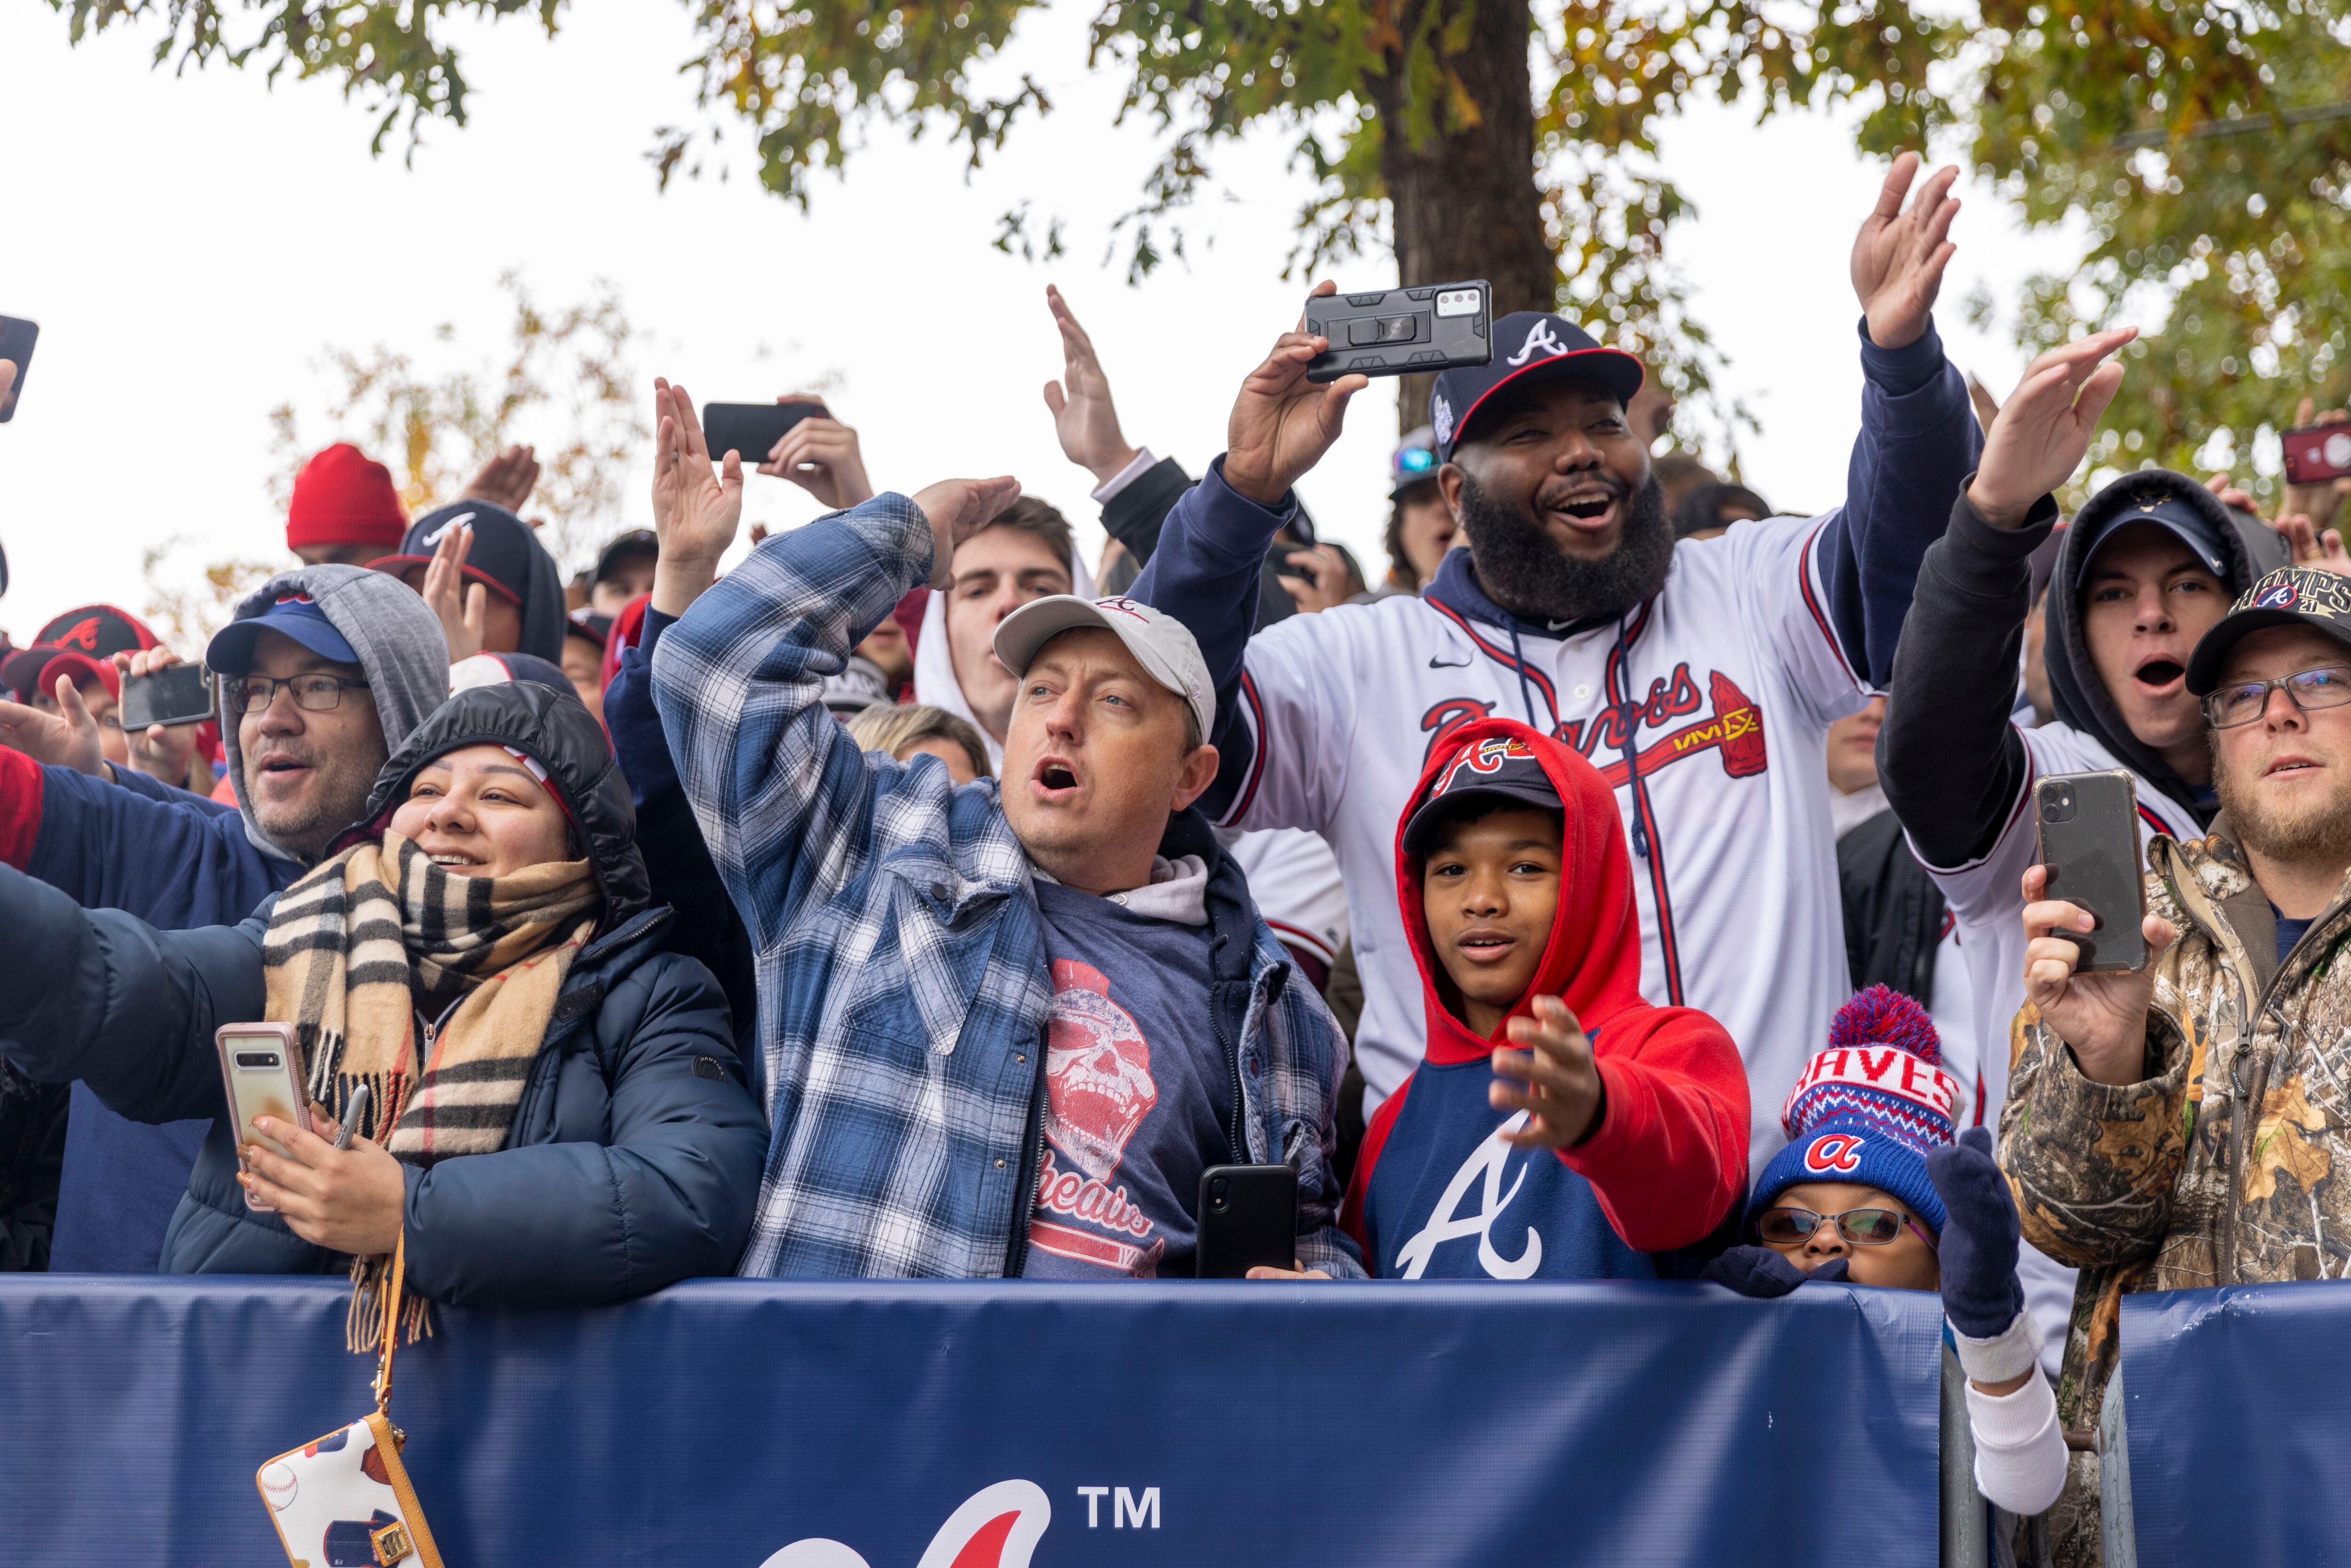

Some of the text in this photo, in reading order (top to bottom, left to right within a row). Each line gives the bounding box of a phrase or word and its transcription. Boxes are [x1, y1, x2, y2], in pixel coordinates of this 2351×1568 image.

[1507, 318, 1568, 366] A
[2256, 585, 2289, 607] A
[2299, 600, 2315, 612] 21
[54, 616, 101, 651] A
[2233, 1072, 2243, 1092] REALTREE
[1396, 1108, 1542, 1279] A
[1077, 1486, 1160, 1528] TM
